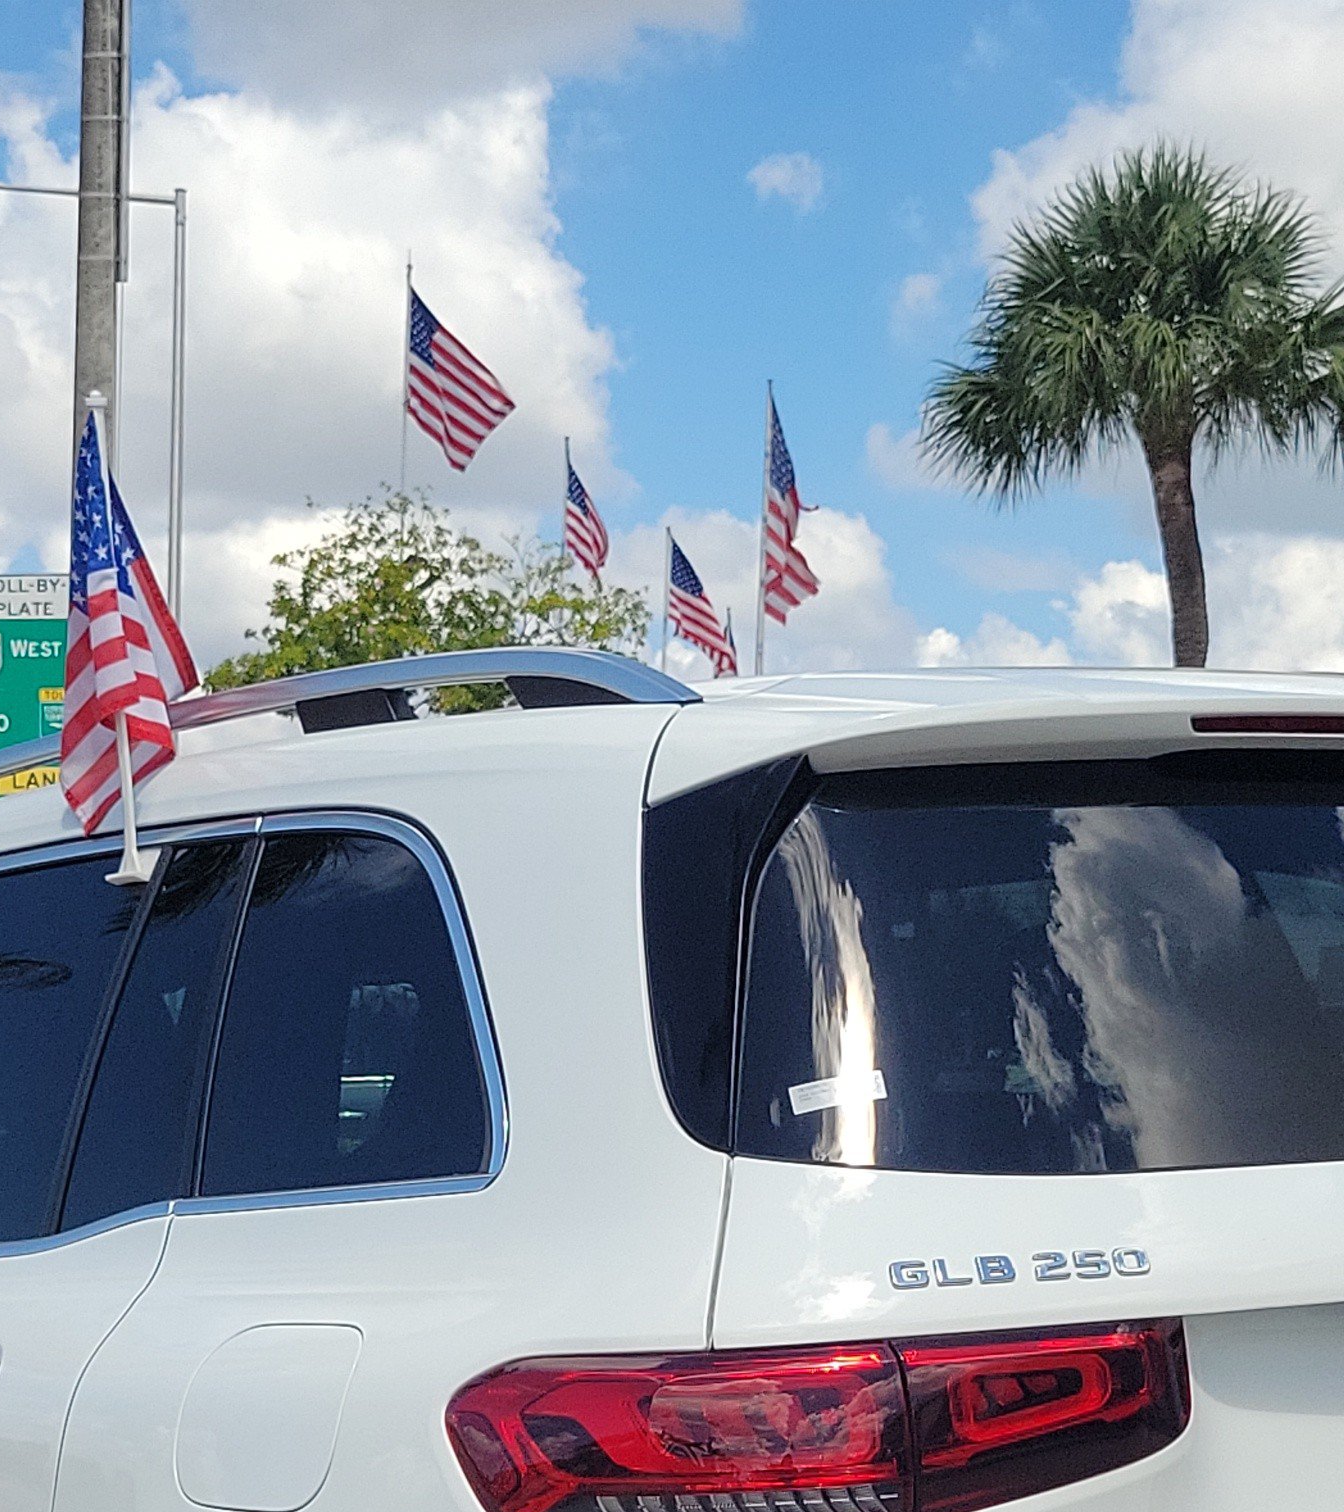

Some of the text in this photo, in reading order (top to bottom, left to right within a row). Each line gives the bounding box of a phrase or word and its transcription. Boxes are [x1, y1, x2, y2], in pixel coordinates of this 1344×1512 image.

[10, 639, 63, 658] WEST
[889, 1246, 1151, 1290] GLB 250
